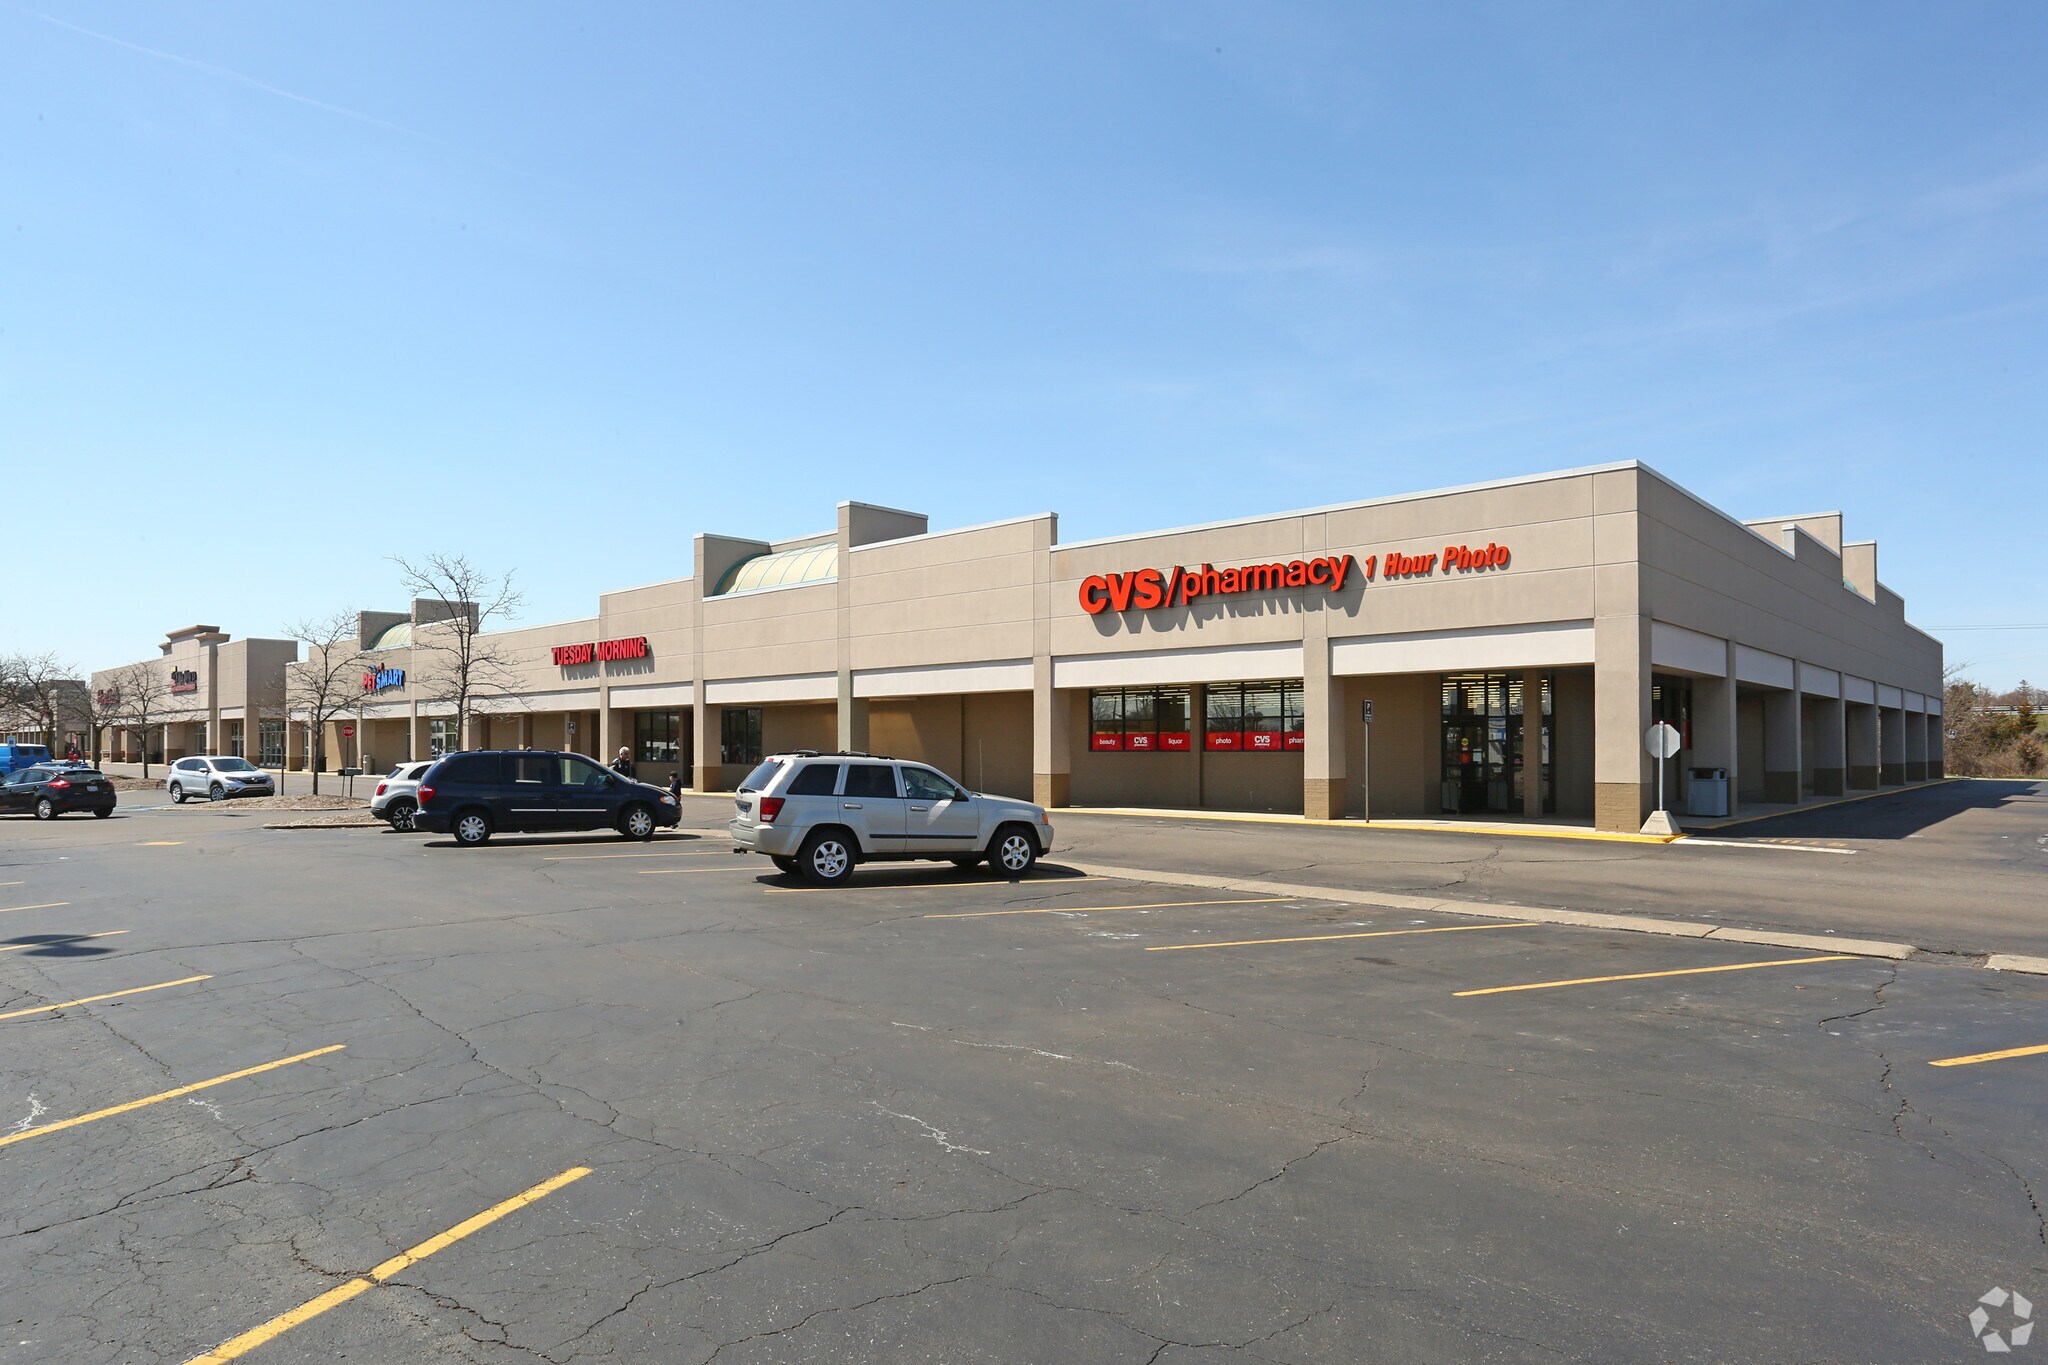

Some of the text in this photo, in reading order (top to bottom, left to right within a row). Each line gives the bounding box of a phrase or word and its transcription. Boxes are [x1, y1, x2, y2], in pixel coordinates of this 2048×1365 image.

[1365, 543, 1510, 579] 1 Hour Photo
[1079, 555, 1350, 614] CVS/pharmacy
[551, 636, 647, 665] TUESDAY MORNING
[1099, 738, 1116, 746] beauty
[1133, 736, 1148, 744] CVS
[1215, 737, 1232, 745] photo
[1254, 735, 1271, 743] CVS
